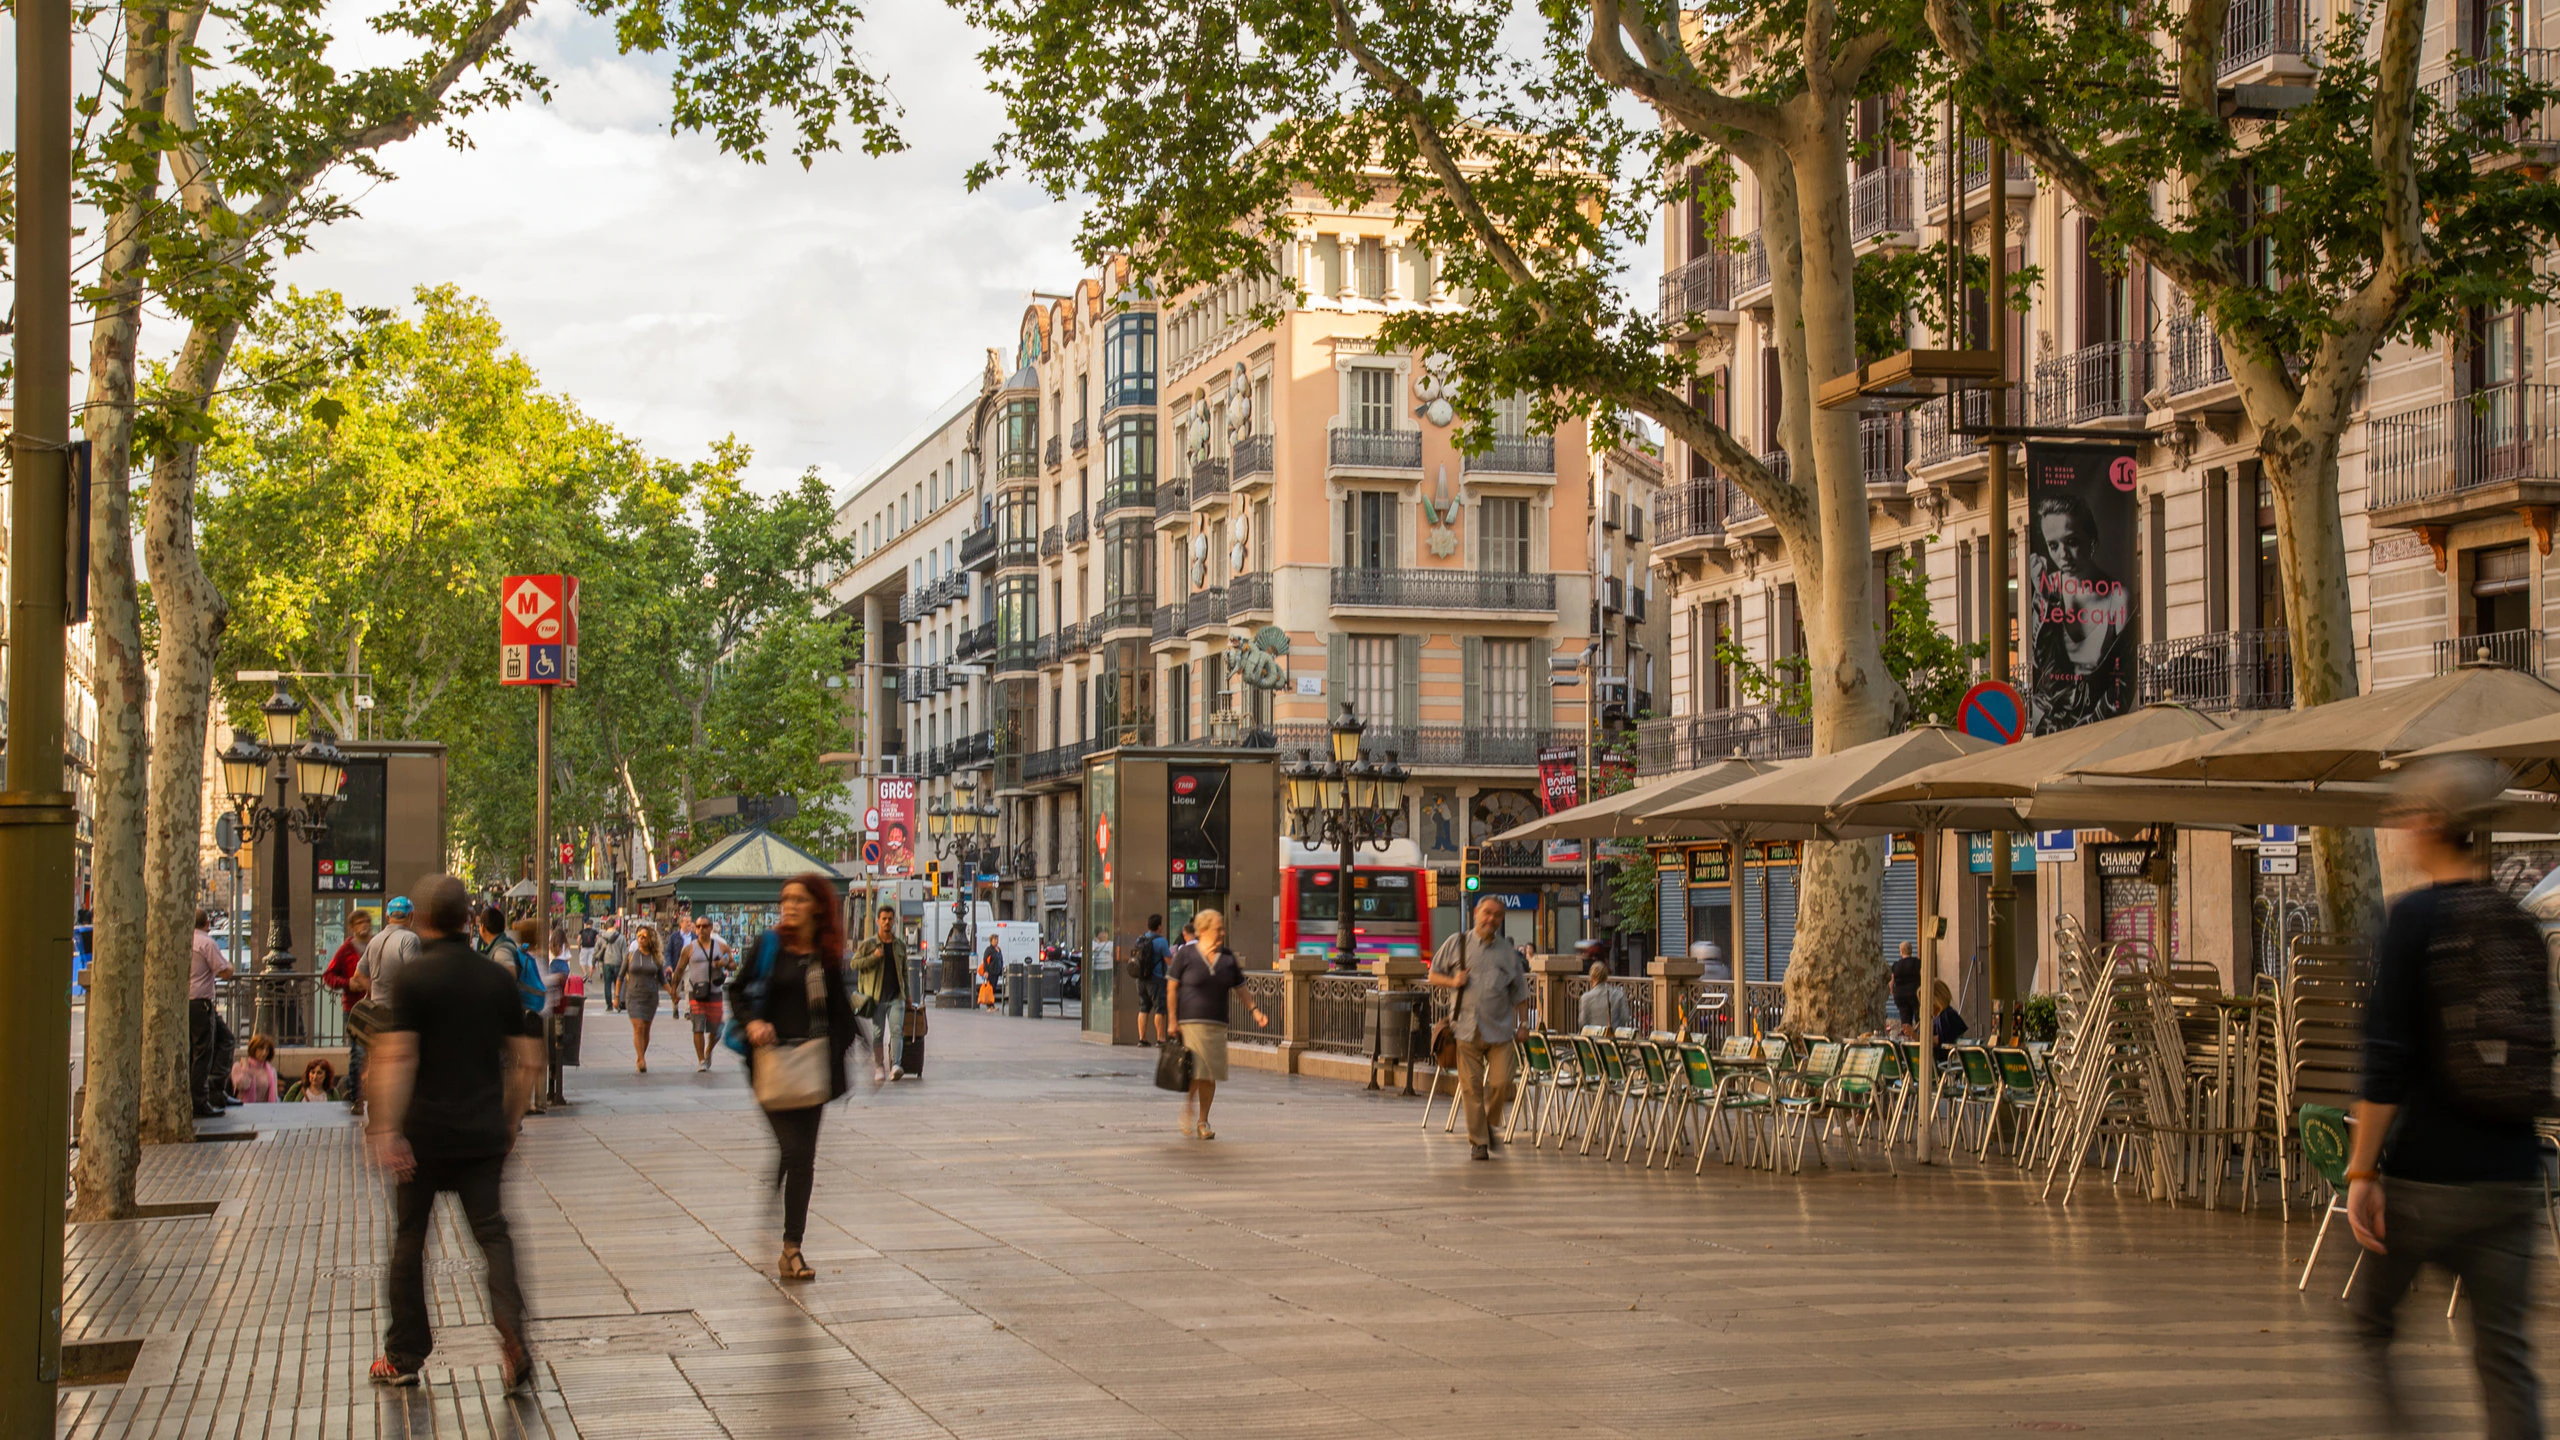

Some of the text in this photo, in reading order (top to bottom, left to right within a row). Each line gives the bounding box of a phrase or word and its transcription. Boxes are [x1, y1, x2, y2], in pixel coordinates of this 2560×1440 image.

[2039, 569, 2123, 597] Manon
[517, 592, 539, 615] M
[2040, 599, 2126, 625] Lescaut
[2049, 673, 2084, 681] PUCCINI
[1540, 751, 1558, 761] BARNA
[1178, 781, 1194, 789] TMB
[1547, 775, 1576, 787] BARRI
[1172, 796, 1196, 805] Liceu
[1696, 851, 1724, 866] FUNDADA
[335, 862, 349, 873] L3
[1186, 861, 1198, 870] L3
[2107, 865, 2138, 874] OFFICIAL
